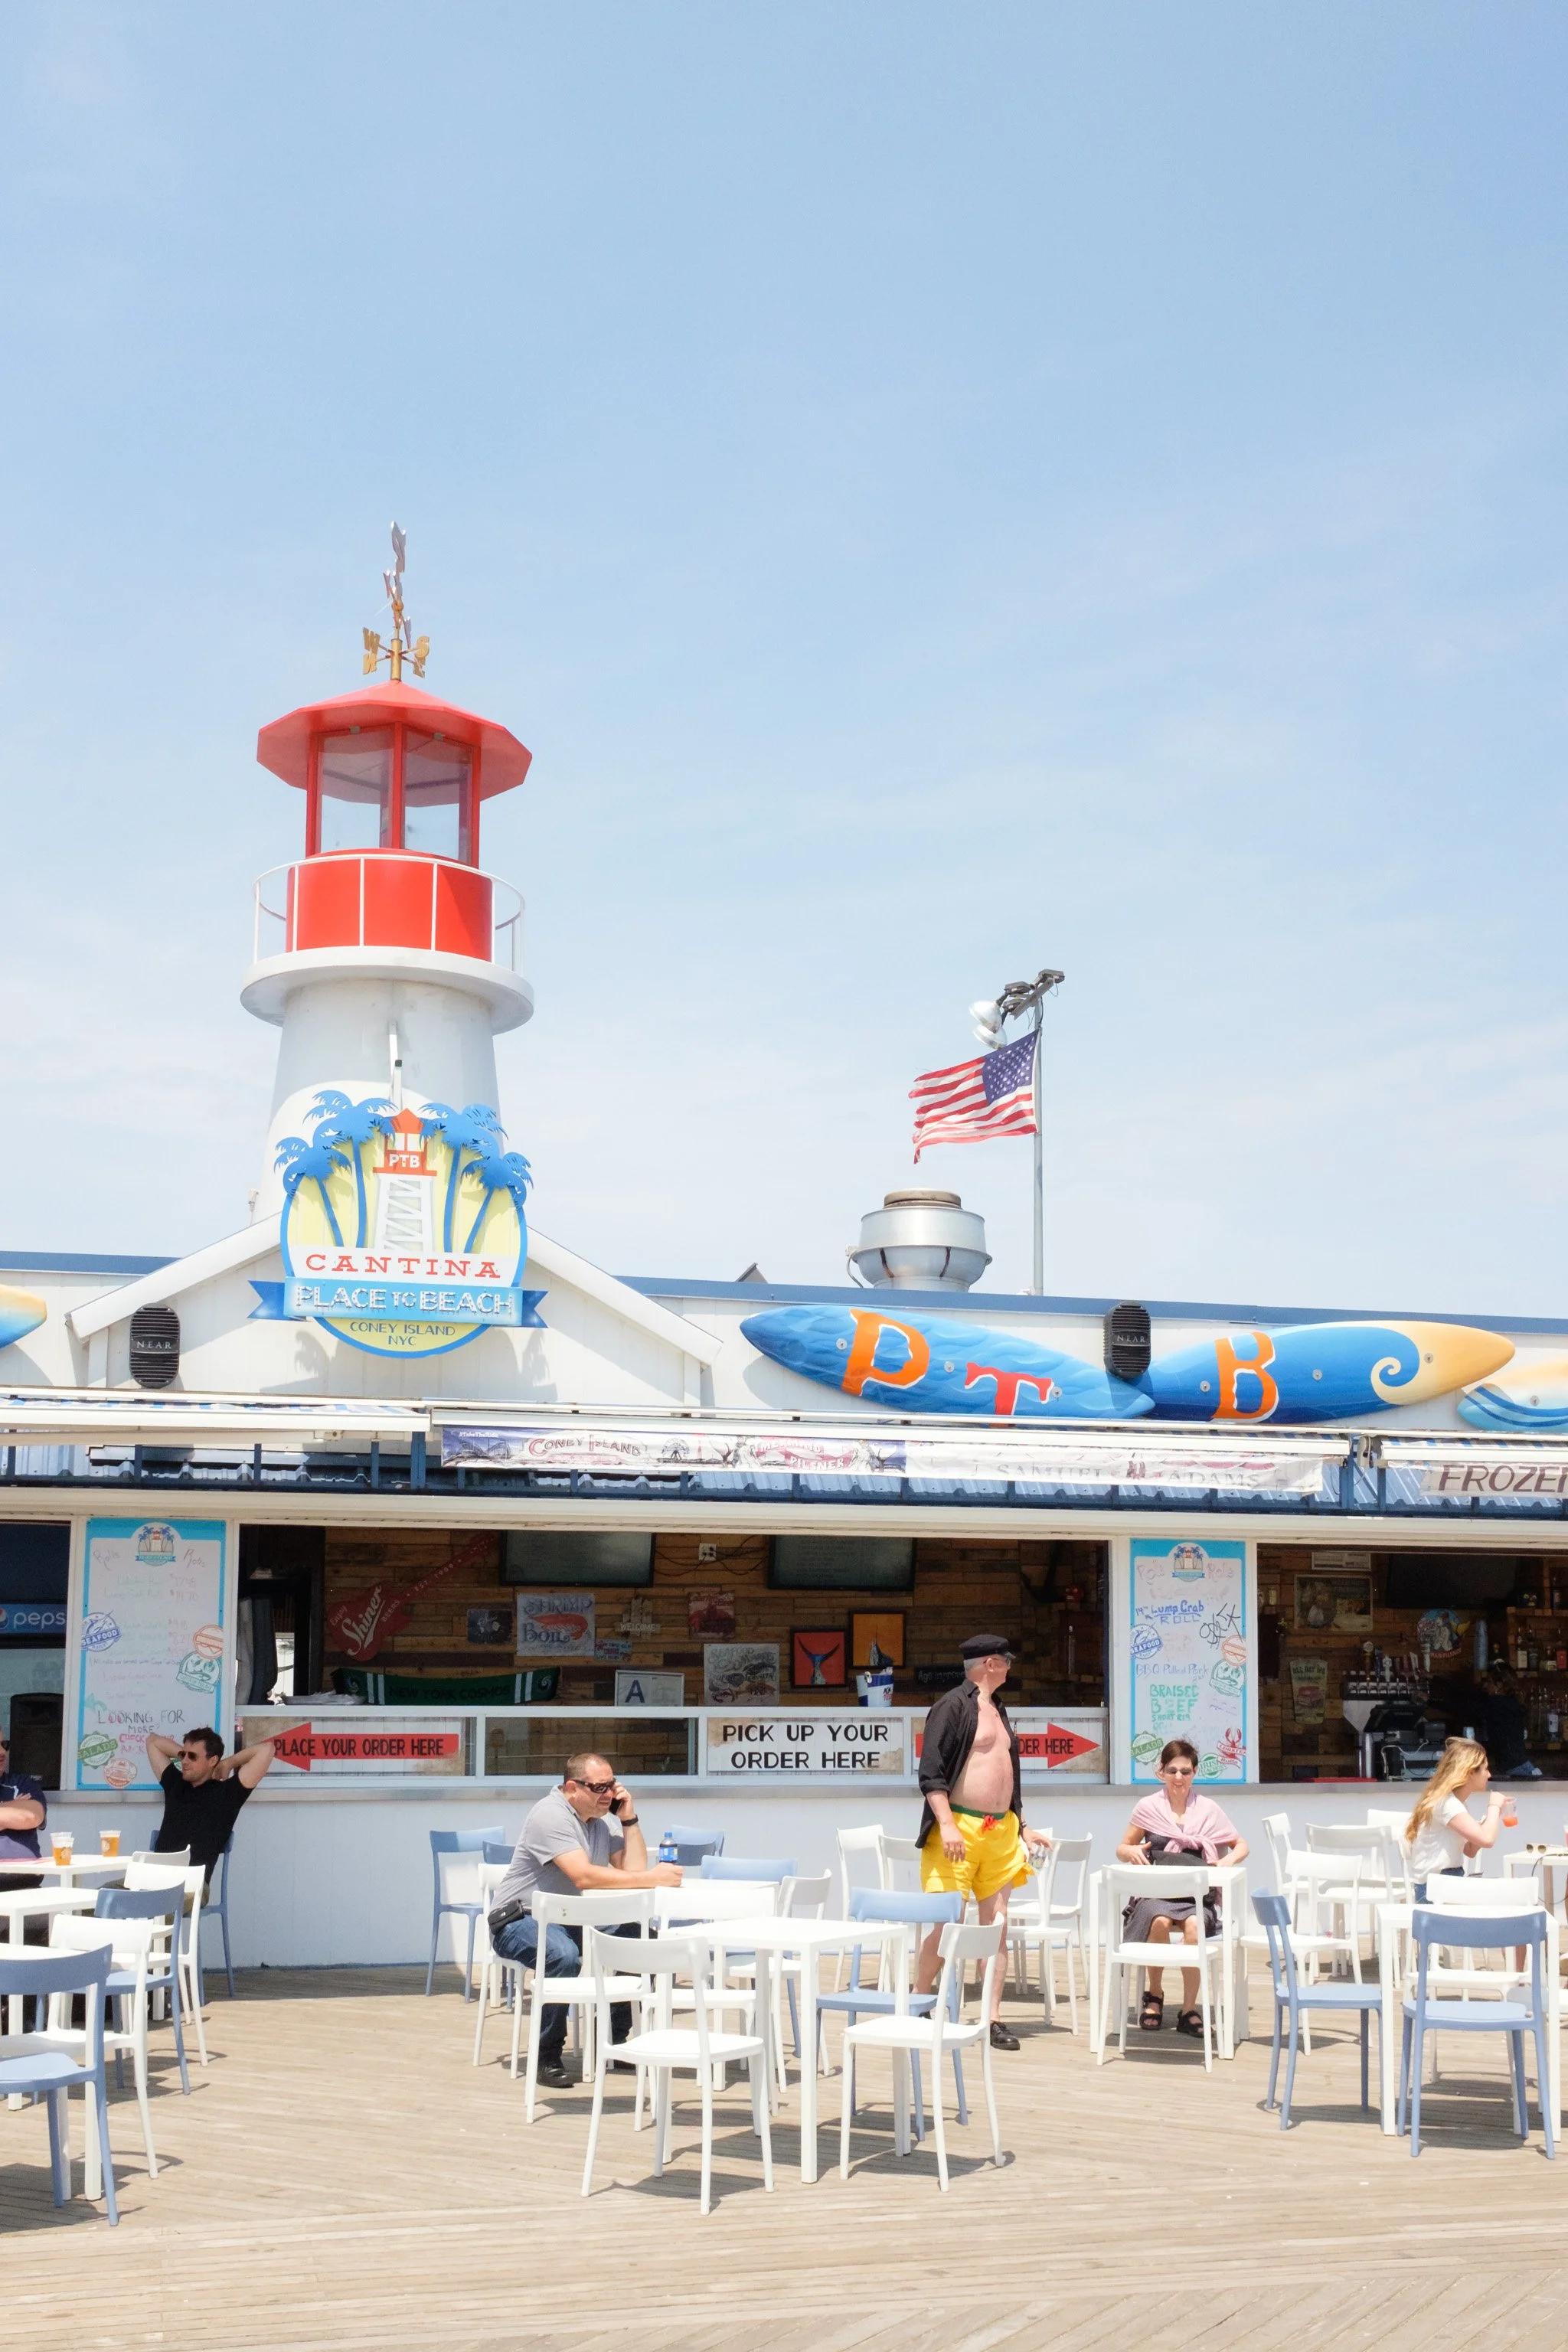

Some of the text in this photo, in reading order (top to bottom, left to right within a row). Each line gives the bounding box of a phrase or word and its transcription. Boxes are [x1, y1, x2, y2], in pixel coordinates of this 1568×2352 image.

[388, 1154, 420, 1168] PTB
[305, 1253, 501, 1279] CANTINA
[294, 1285, 514, 1315] PLACE TO BEACH
[350, 1321, 456, 1336] CONEY ISLAND
[136, 1341, 172, 1349] NEAR
[388, 1335, 417, 1347] NYC
[528, 1434, 642, 1457] CONEY ISLAND
[789, 1457, 846, 1472] PILSNER
[1168, 1470, 1262, 1487] ADAMS
[381, 1599, 401, 1623] BEERS
[523, 1596, 593, 1615] SHRIMP
[1151, 1603, 1178, 1614] Lump
[1180, 1599, 1204, 1613] Crab
[14, 1610, 67, 1628] peps
[341, 1585, 383, 1656] Shiner
[620, 1623, 656, 1632] WELCOME
[1160, 1614, 1200, 1625] ROLL
[81, 1629, 118, 1646] SEAFOOD
[1136, 1662, 1209, 1677] BBQ Pulled Pork
[420, 1687, 456, 1700] YORK
[459, 1685, 511, 1699] COSMOS
[625, 1679, 645, 1703] A
[97, 1709, 186, 1724] LOOKING FOR
[722, 1724, 888, 1742] PICK UP YOUR
[274, 1739, 444, 1756] PLACE YOUR ORDER HERE
[1019, 1739, 1074, 1754] DER HERE
[731, 1751, 880, 1769] ORDER HERE
